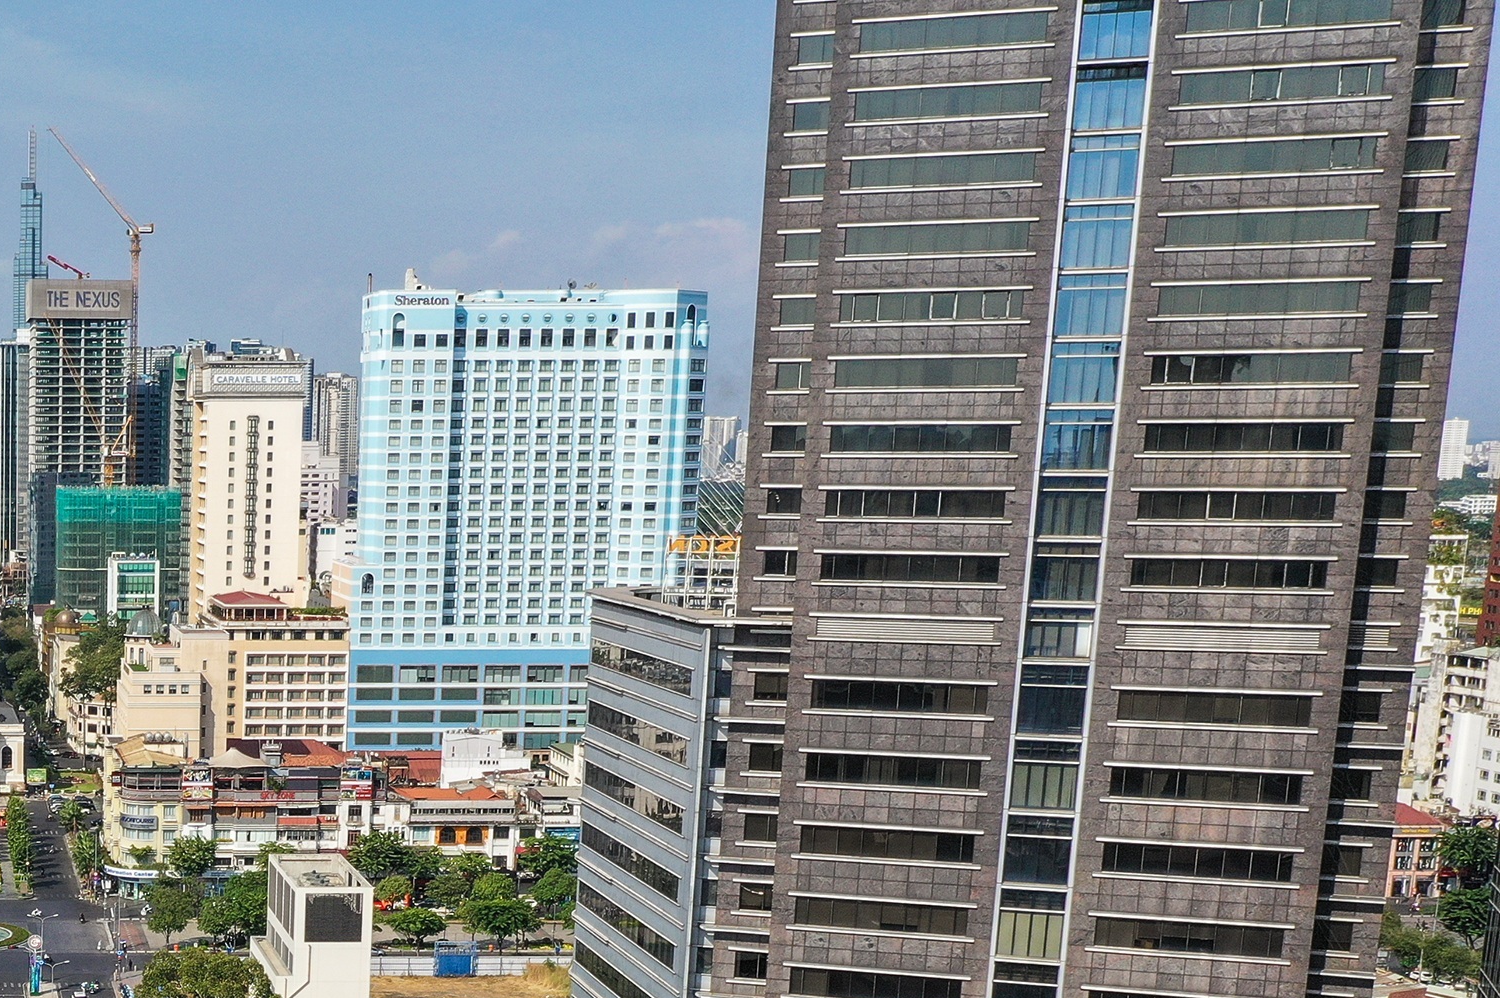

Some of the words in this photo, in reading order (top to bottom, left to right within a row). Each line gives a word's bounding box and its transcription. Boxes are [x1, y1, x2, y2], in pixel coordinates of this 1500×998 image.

[47, 291, 69, 308] THE
[76, 291, 120, 308] NEXUS
[395, 295, 449, 306] Sheraton
[217, 375, 267, 383] CARAVELLE
[270, 375, 299, 383] HOTEL
